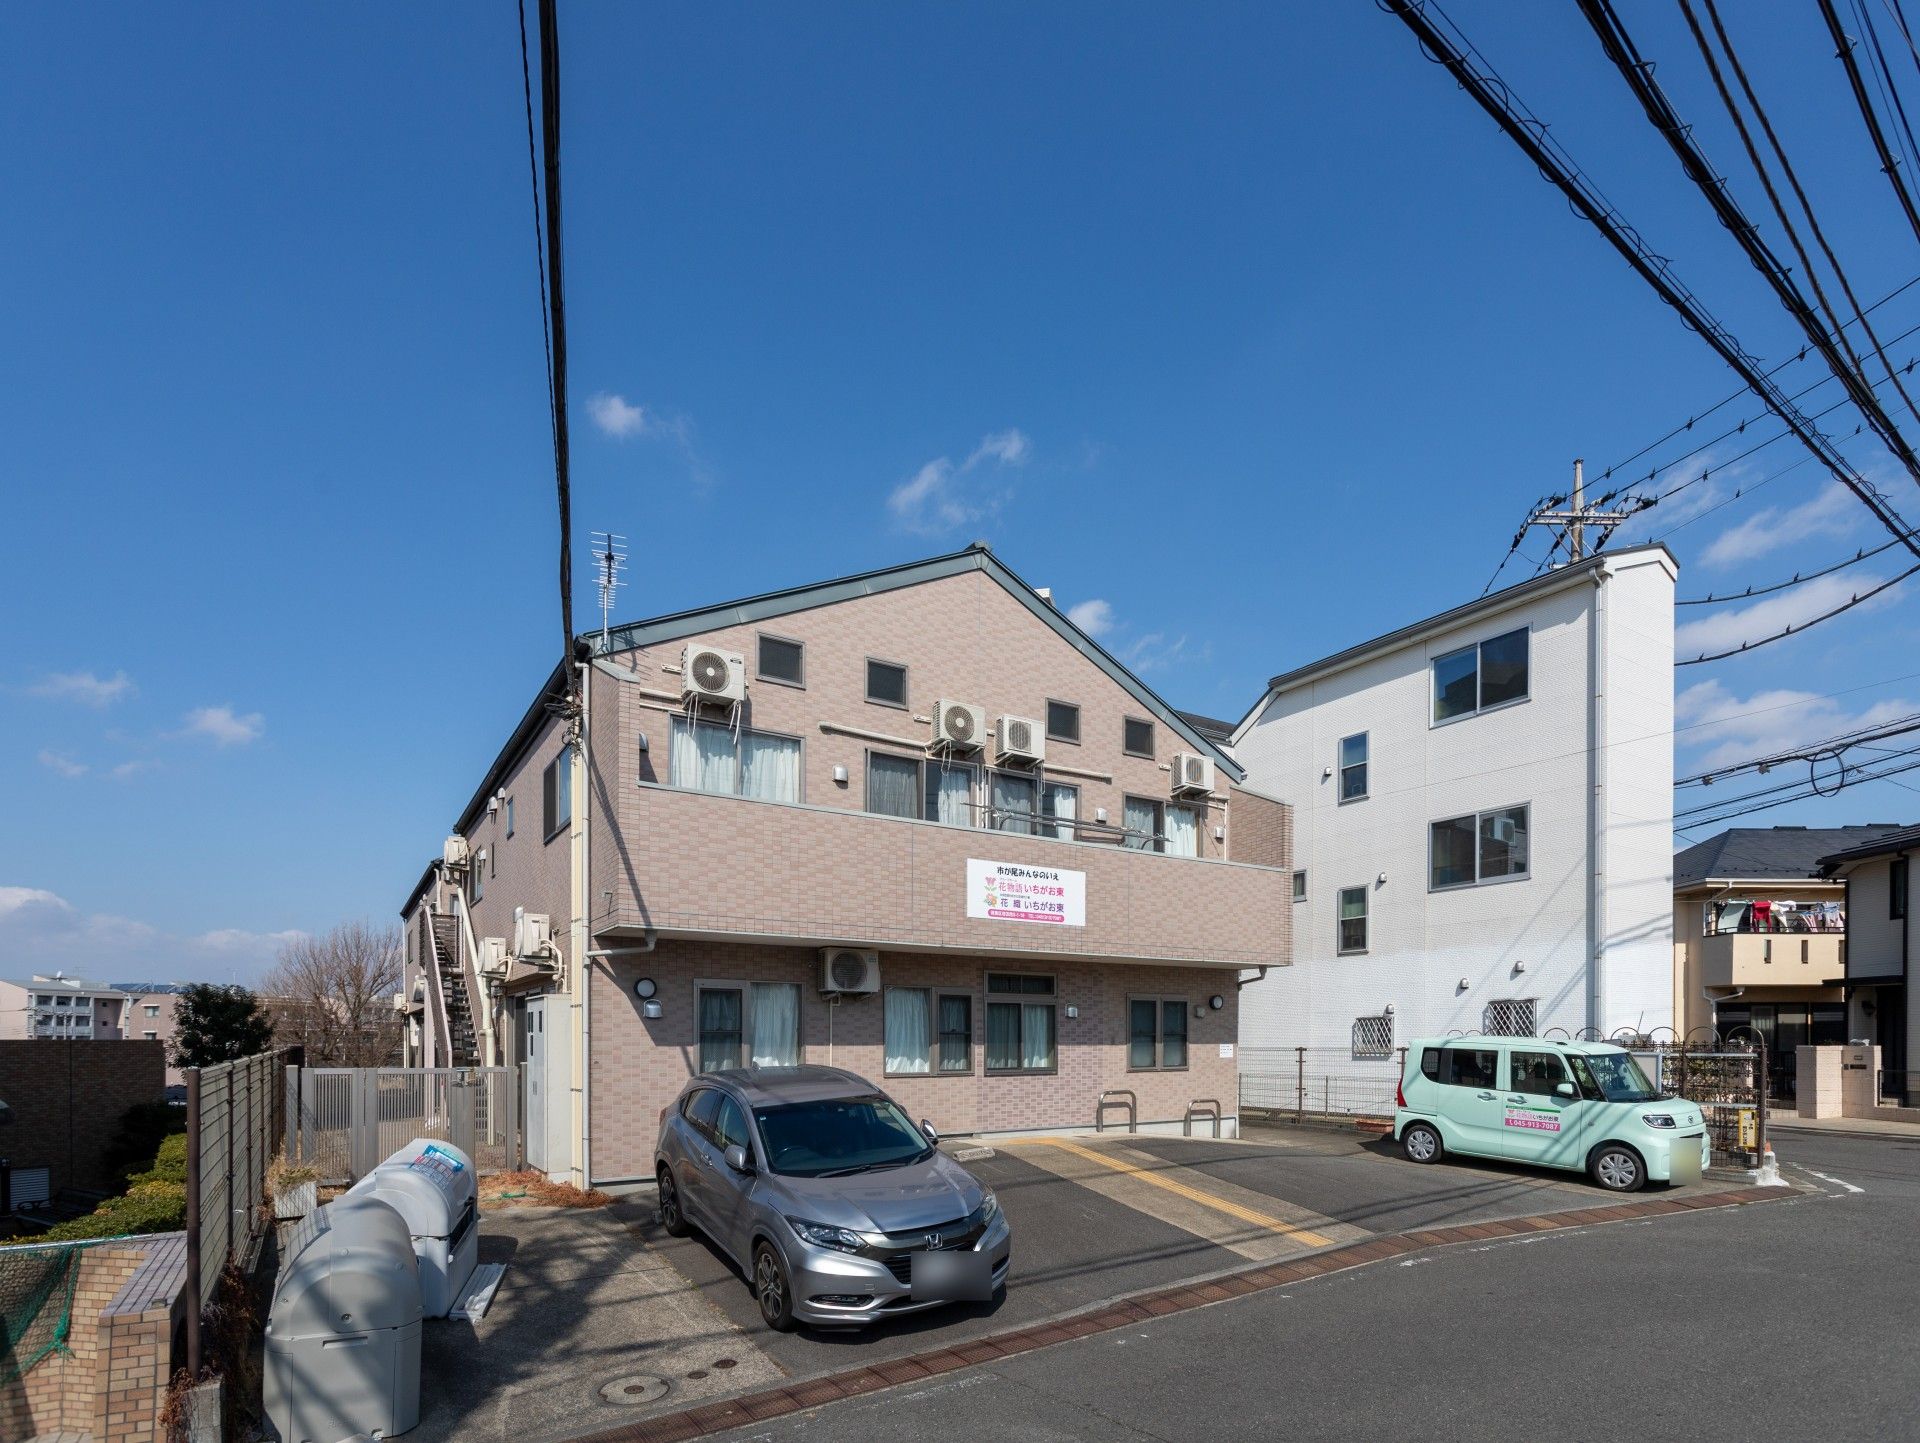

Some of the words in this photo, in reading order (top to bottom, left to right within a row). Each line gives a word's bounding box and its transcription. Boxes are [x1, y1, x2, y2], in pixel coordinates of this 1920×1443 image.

[997, 866, 1059, 881] 市が尾みんなのいえ
[1513, 1120, 1559, 1130] 045-913-7087
